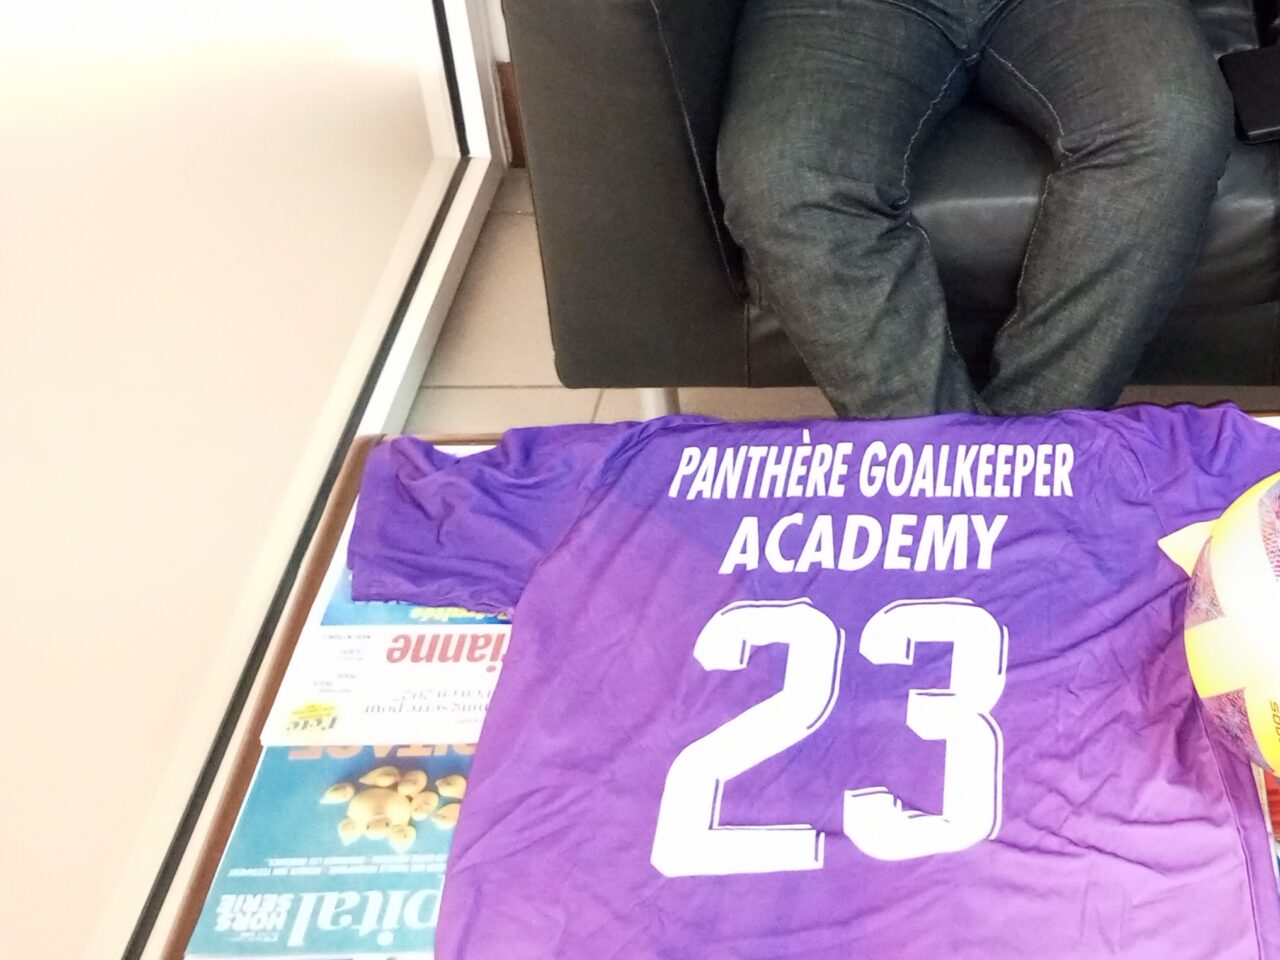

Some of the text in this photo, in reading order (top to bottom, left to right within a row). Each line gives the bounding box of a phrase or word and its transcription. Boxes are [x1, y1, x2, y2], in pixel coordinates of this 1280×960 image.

[668, 428, 1075, 500] PANTHÈRE GOALKEEPER
[718, 511, 1009, 575] ACADEMY
[386, 632, 508, 673] ianne
[650, 596, 1009, 878] 23
[214, 909, 289, 932] HORS
